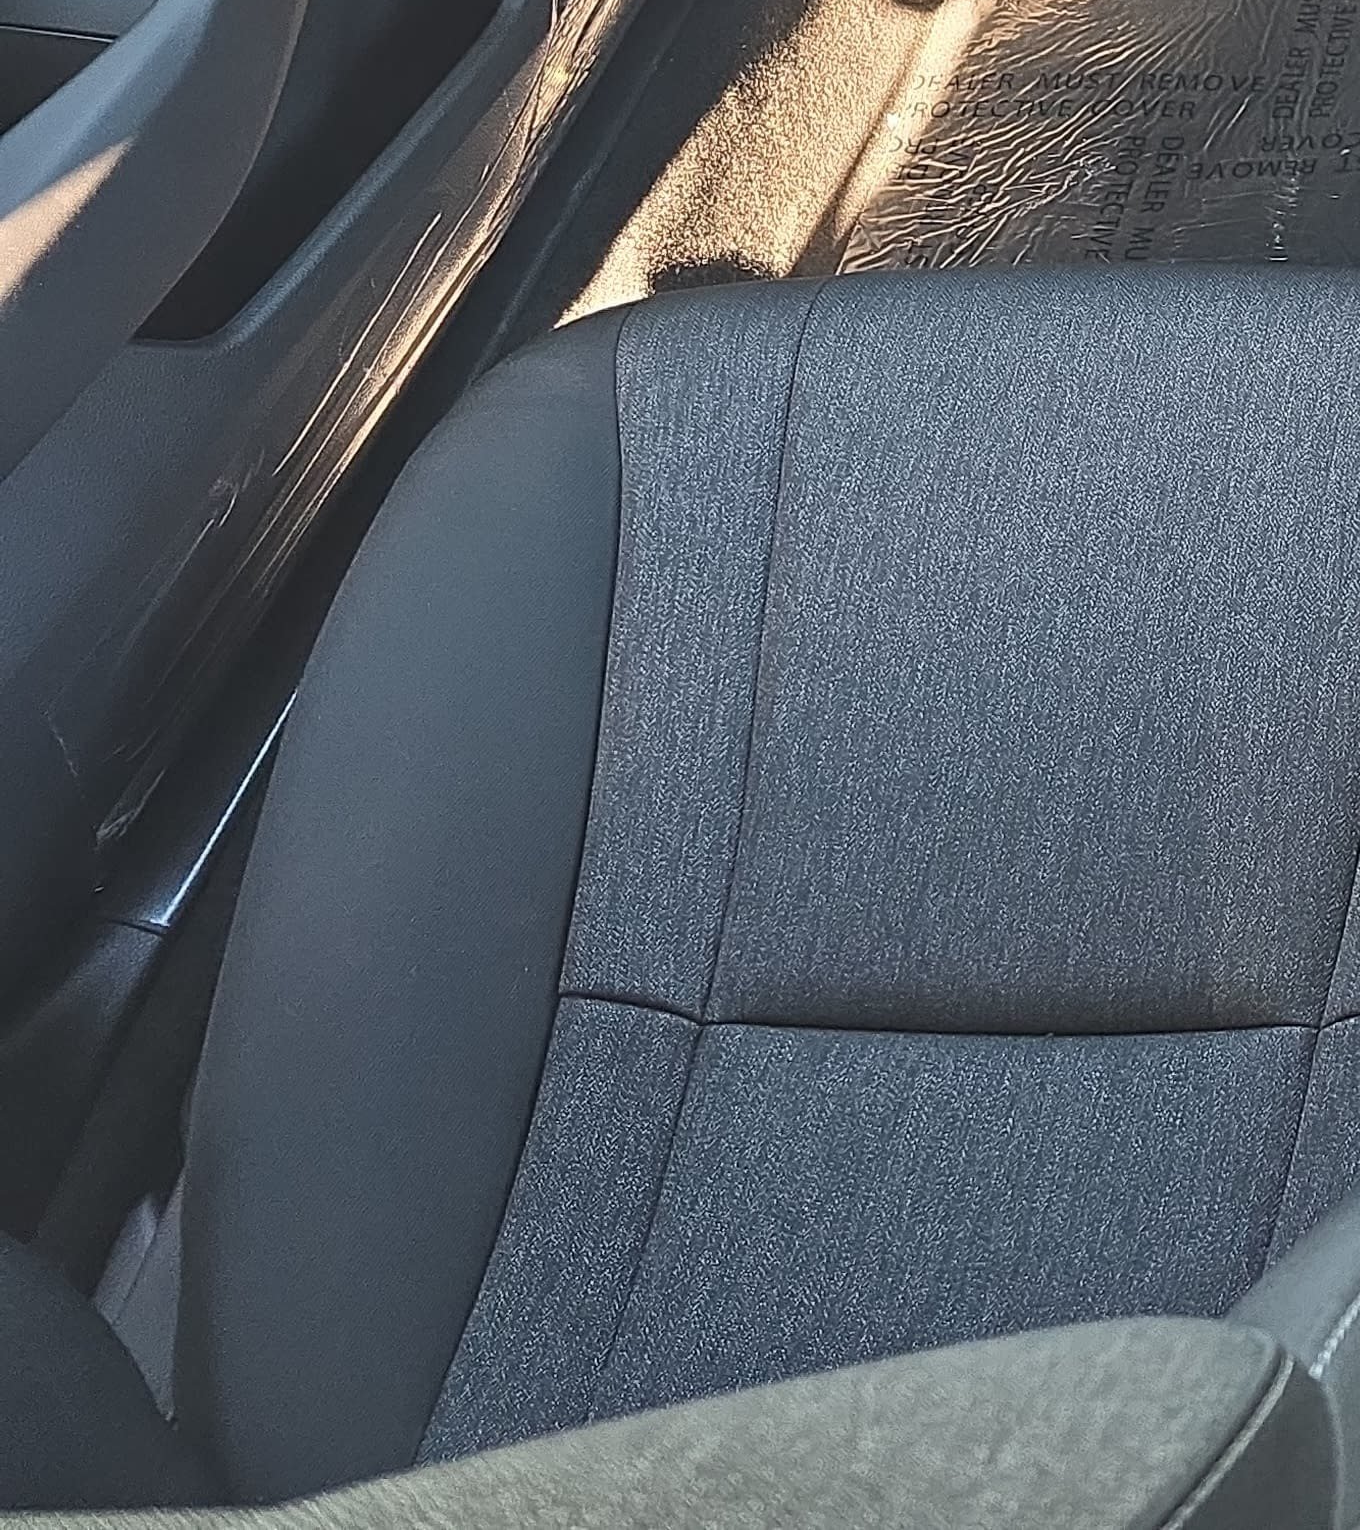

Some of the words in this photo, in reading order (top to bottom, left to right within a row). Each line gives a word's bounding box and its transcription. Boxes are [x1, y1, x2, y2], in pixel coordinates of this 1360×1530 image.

[1036, 71, 1121, 90] MUST
[1141, 73, 1267, 93] REMOVE
[1272, 47, 1312, 120] DEALER
[1308, 4, 1358, 119] PROTECTIVE
[1093, 99, 1197, 118] COVER
[1138, 135, 1186, 214] DEALER
